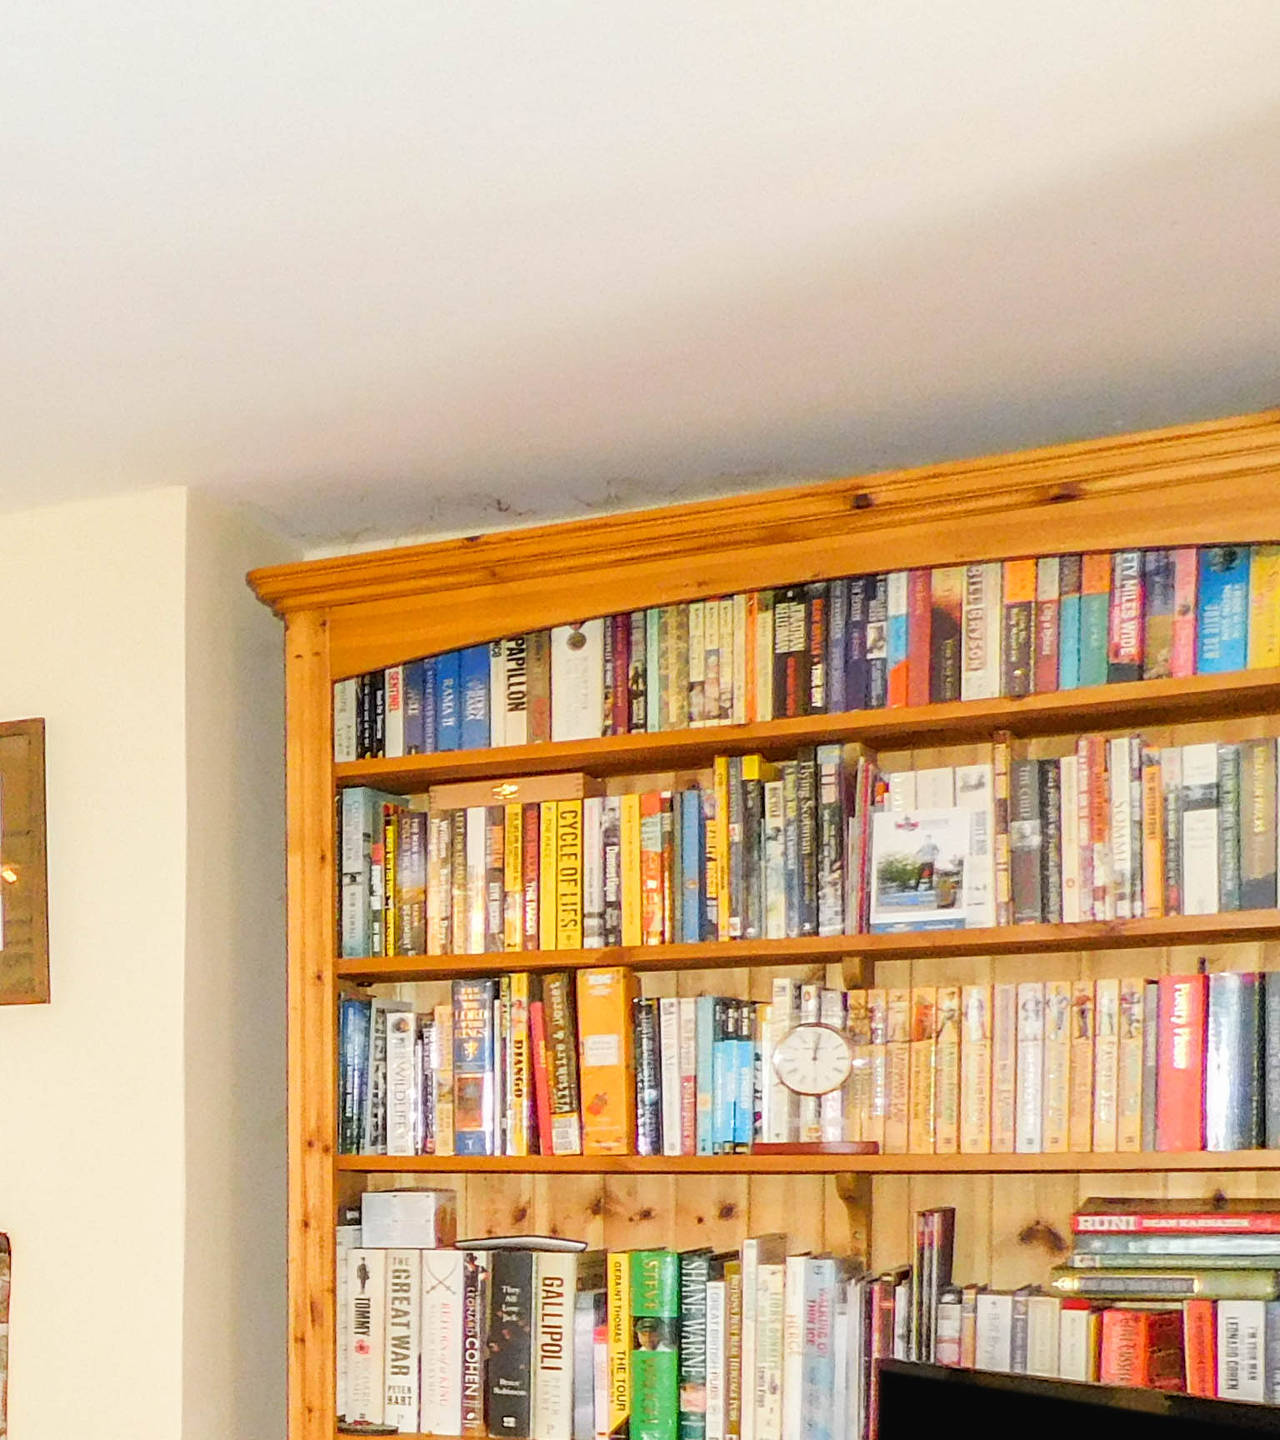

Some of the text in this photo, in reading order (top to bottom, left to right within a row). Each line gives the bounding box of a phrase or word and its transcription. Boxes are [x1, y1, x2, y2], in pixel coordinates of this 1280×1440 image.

[967, 566, 983, 671] BILL BRYSON
[1120, 580, 1137, 619] MILES
[1120, 621, 1136, 656] WIDE
[388, 671, 400, 713] SENTINEL
[441, 678, 455, 715] RAMA
[506, 637, 527, 713] PAPILLON
[560, 810, 578, 863] CYCLE
[801, 799, 813, 854] Scotsman
[560, 867, 578, 888] OF
[550, 981, 565, 1025] Dorset
[394, 1061, 407, 1129] WILDLIFE
[513, 1039, 524, 1099] DJANGO
[552, 1043, 570, 1112] Wiltshire
[393, 1256, 410, 1266] THE
[643, 1259, 659, 1310] STEVE
[353, 1297, 371, 1336] TOMMY
[390, 1268, 412, 1377] GREAT WAR
[464, 1287, 480, 1396] LEONARD COHEN
[540, 1276, 564, 1371] GALLIPOLI
[613, 1261, 627, 1412] GERAINT THOMAS THE TOUR
[681, 1260, 706, 1377] SHANE WARNE
[1225, 1317, 1239, 1390] LEONARD COHEN
